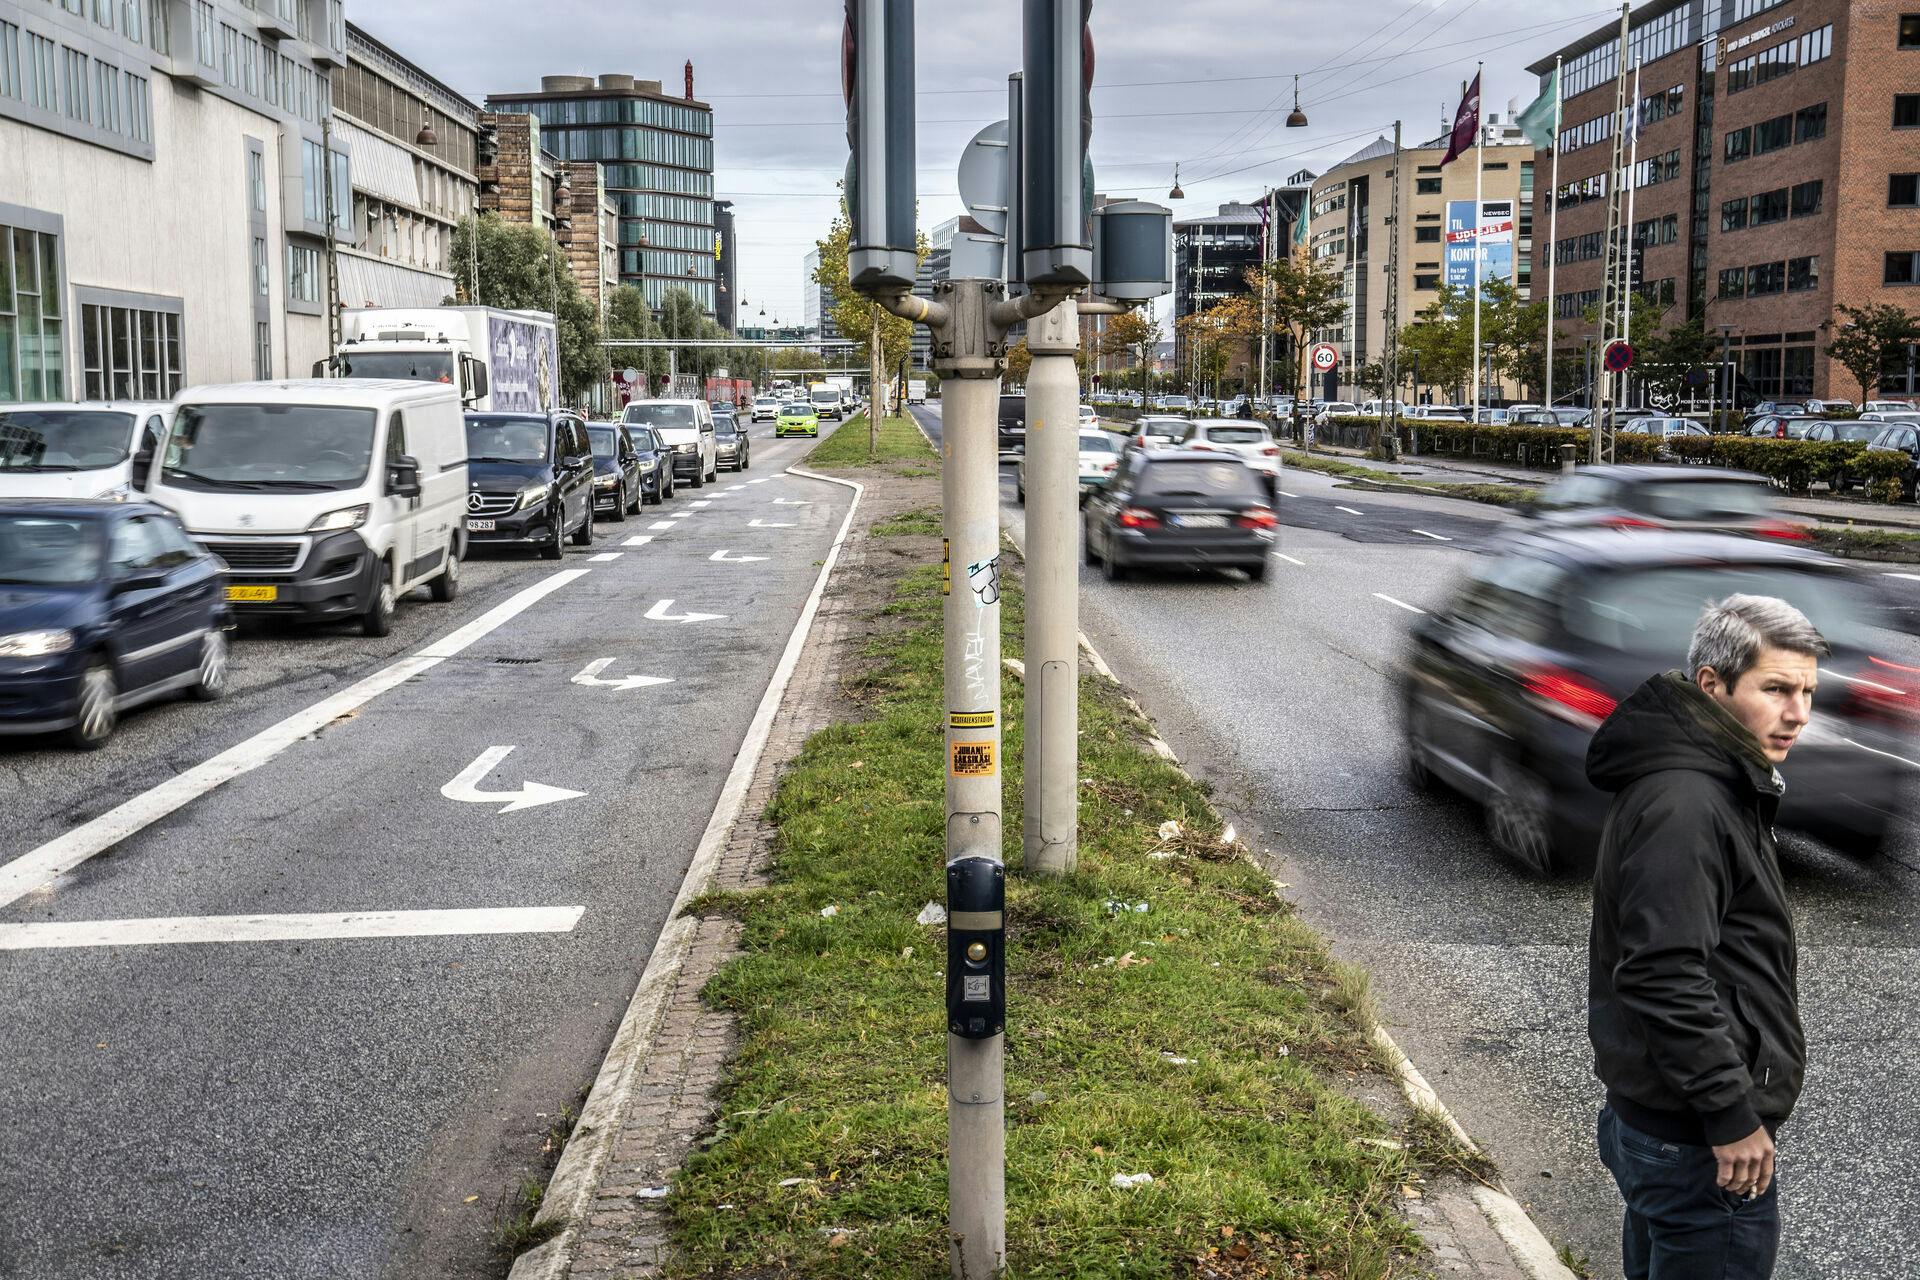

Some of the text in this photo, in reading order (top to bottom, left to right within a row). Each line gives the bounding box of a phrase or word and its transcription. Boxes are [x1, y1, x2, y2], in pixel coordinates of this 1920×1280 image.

[1451, 219, 1463, 230] TIL
[1455, 224, 1503, 239] UDLEJET
[1317, 353, 1333, 363] 60
